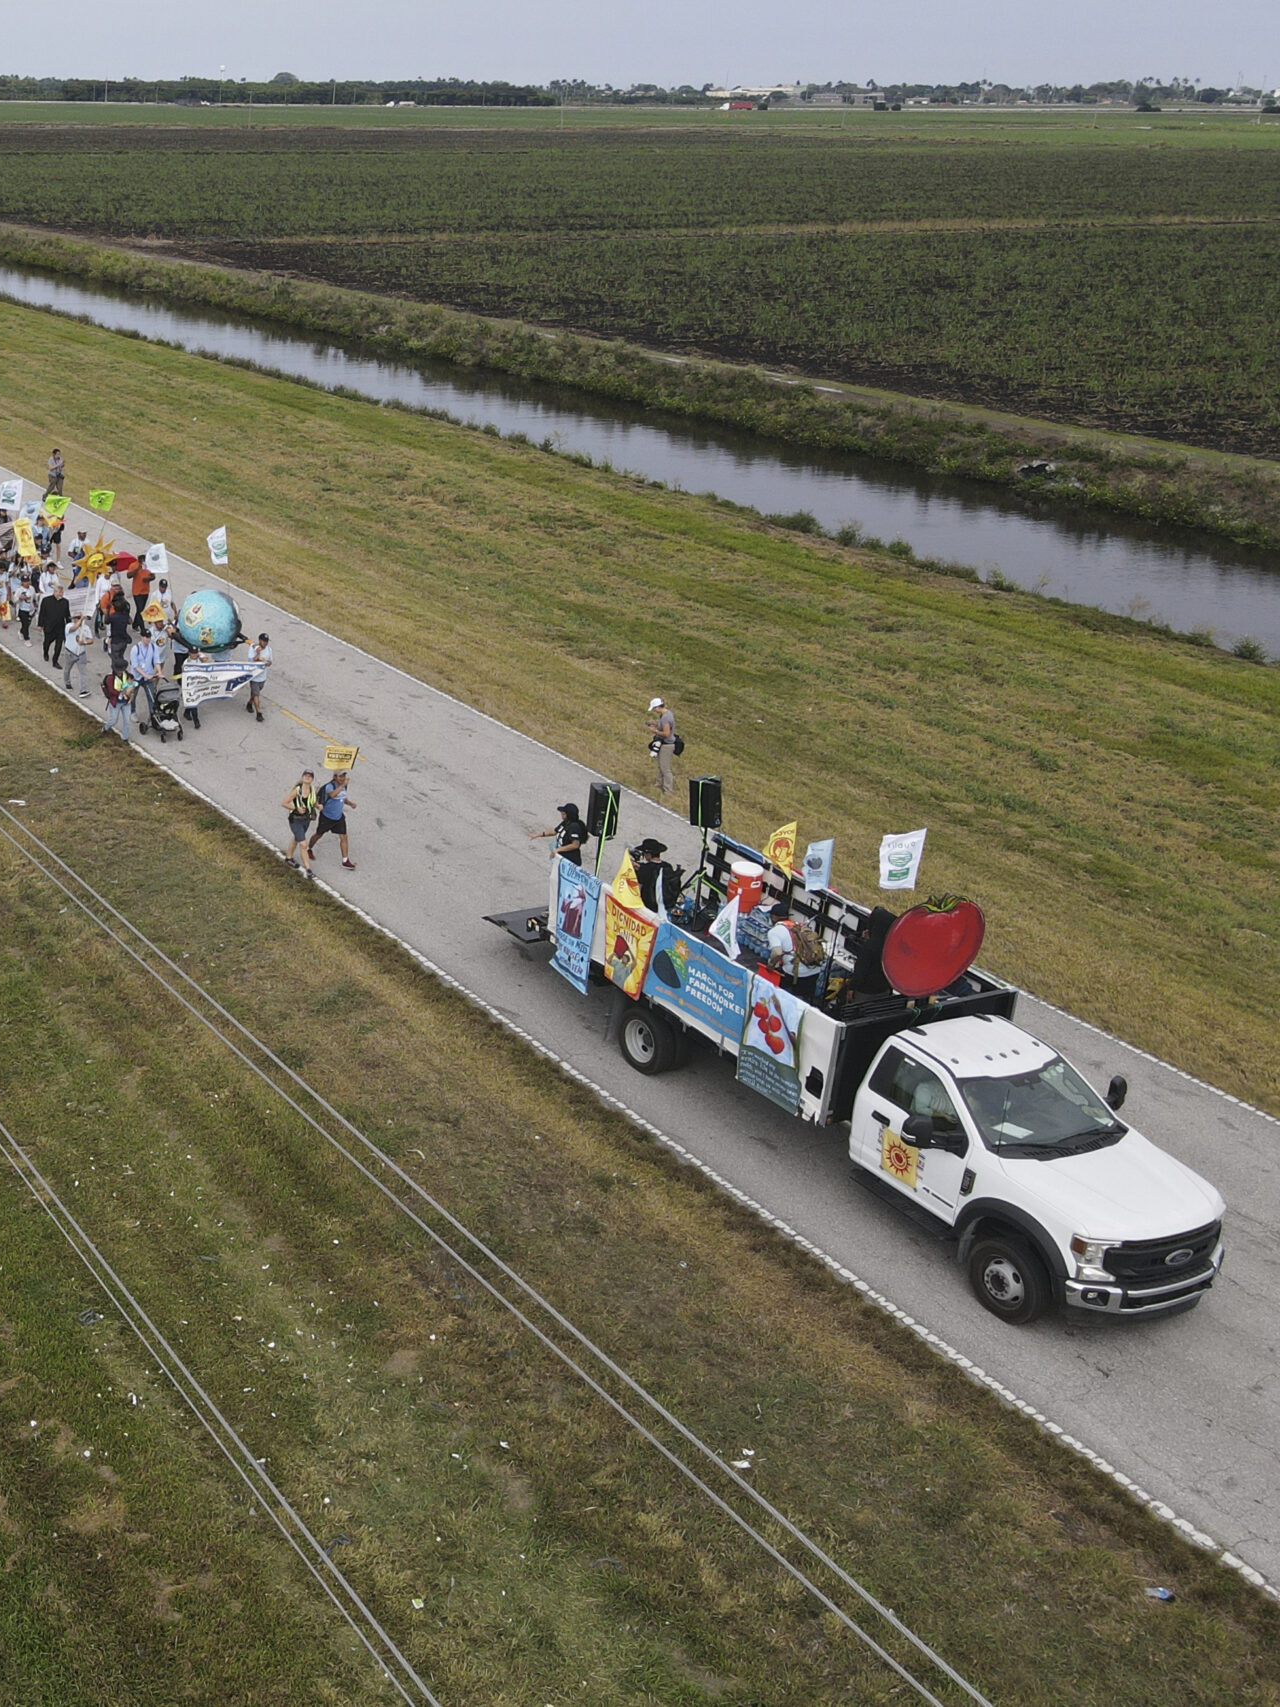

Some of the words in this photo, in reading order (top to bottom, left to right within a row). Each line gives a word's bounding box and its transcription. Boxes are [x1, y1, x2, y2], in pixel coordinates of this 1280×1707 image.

[612, 904, 647, 937] DIGNIDAD
[613, 922, 641, 947] DIGNITY
[685, 985, 724, 1015] FREEDOM
[688, 966, 717, 989] MARCH
[718, 985, 735, 1001] FOR
[688, 977, 746, 1016] FARMWORKER
